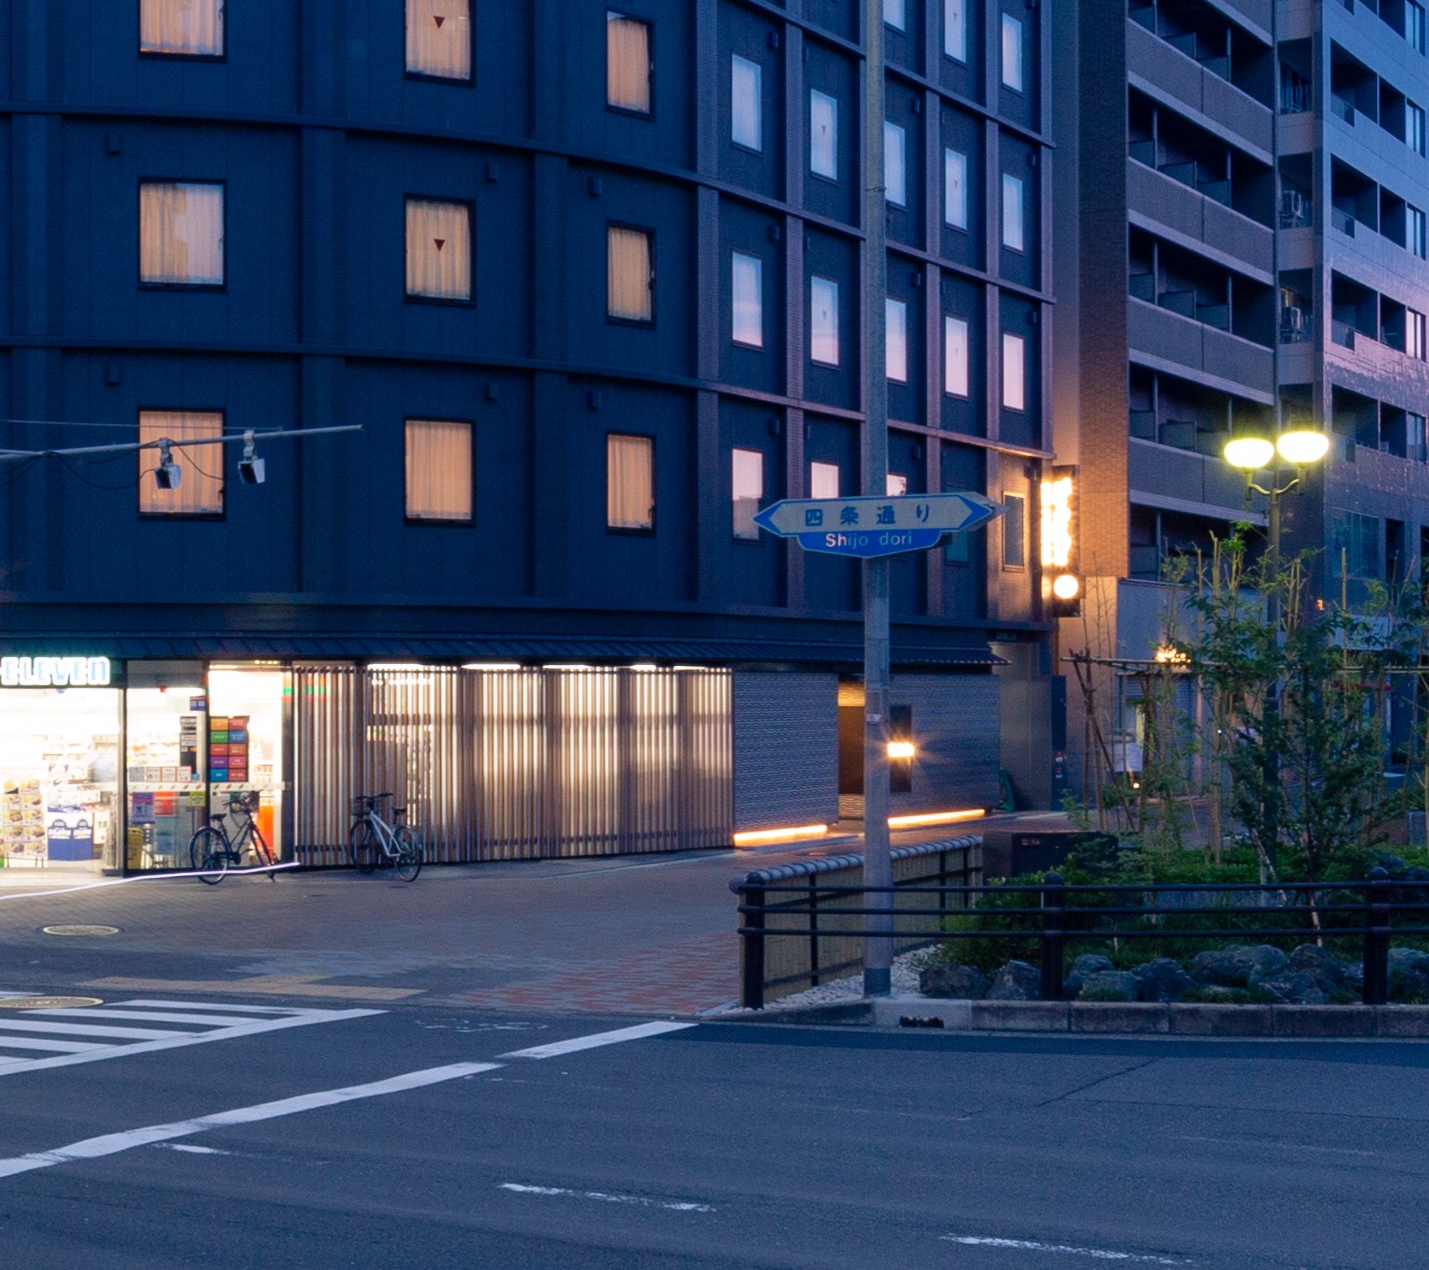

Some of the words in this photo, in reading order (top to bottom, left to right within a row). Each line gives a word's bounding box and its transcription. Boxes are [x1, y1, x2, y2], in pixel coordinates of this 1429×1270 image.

[805, 504, 930, 527] 四条通り
[825, 532, 869, 550] Shijo
[879, 531, 912, 546] dori
